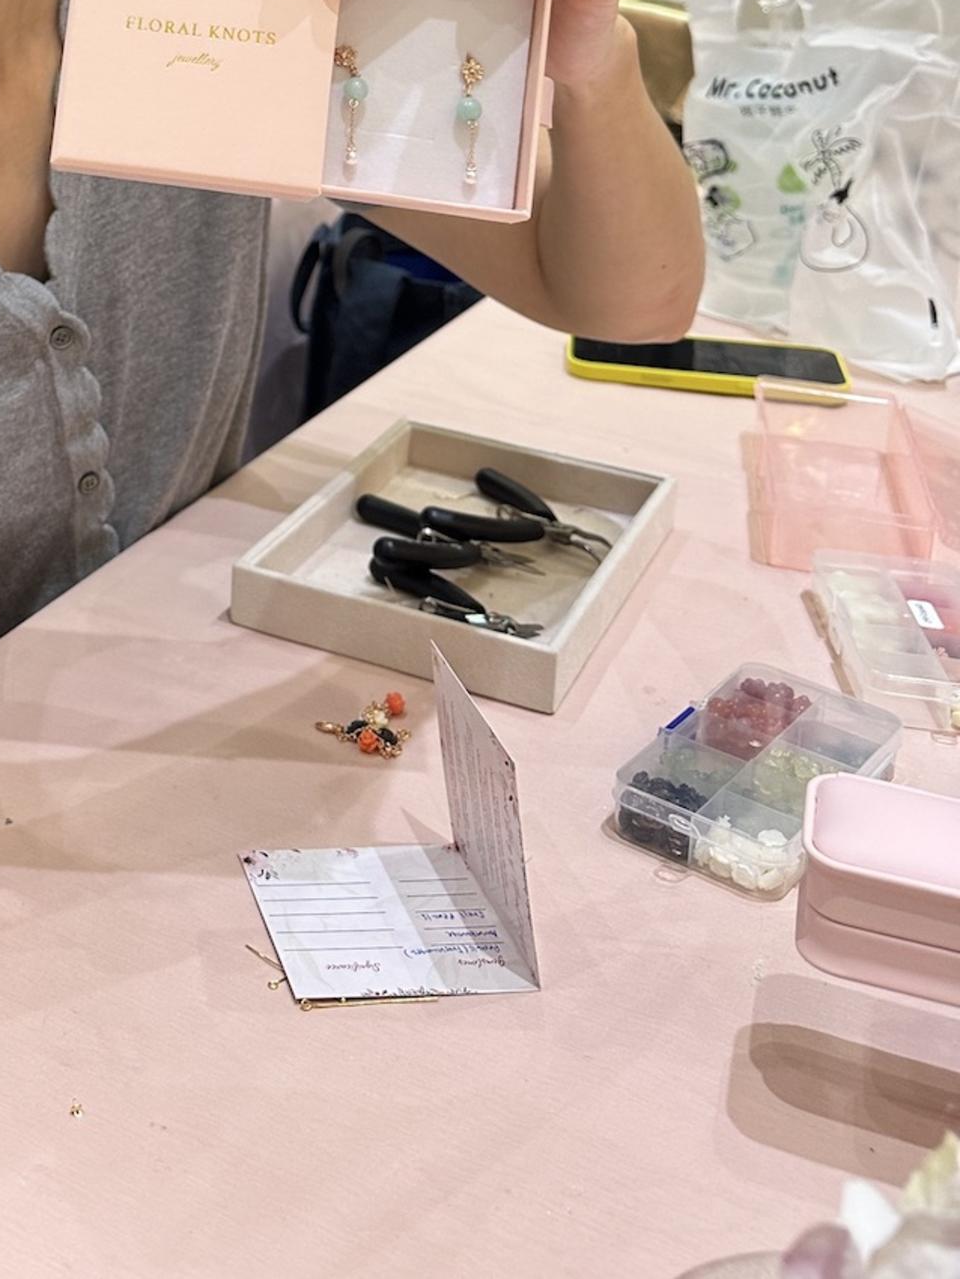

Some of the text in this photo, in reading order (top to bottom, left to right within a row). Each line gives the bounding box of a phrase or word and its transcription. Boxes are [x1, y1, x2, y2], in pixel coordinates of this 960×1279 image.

[125, 15, 278, 46] FLORAL KNOTS
[166, 52, 222, 72] jewellery
[705, 66, 840, 100] Mr. Coconut
